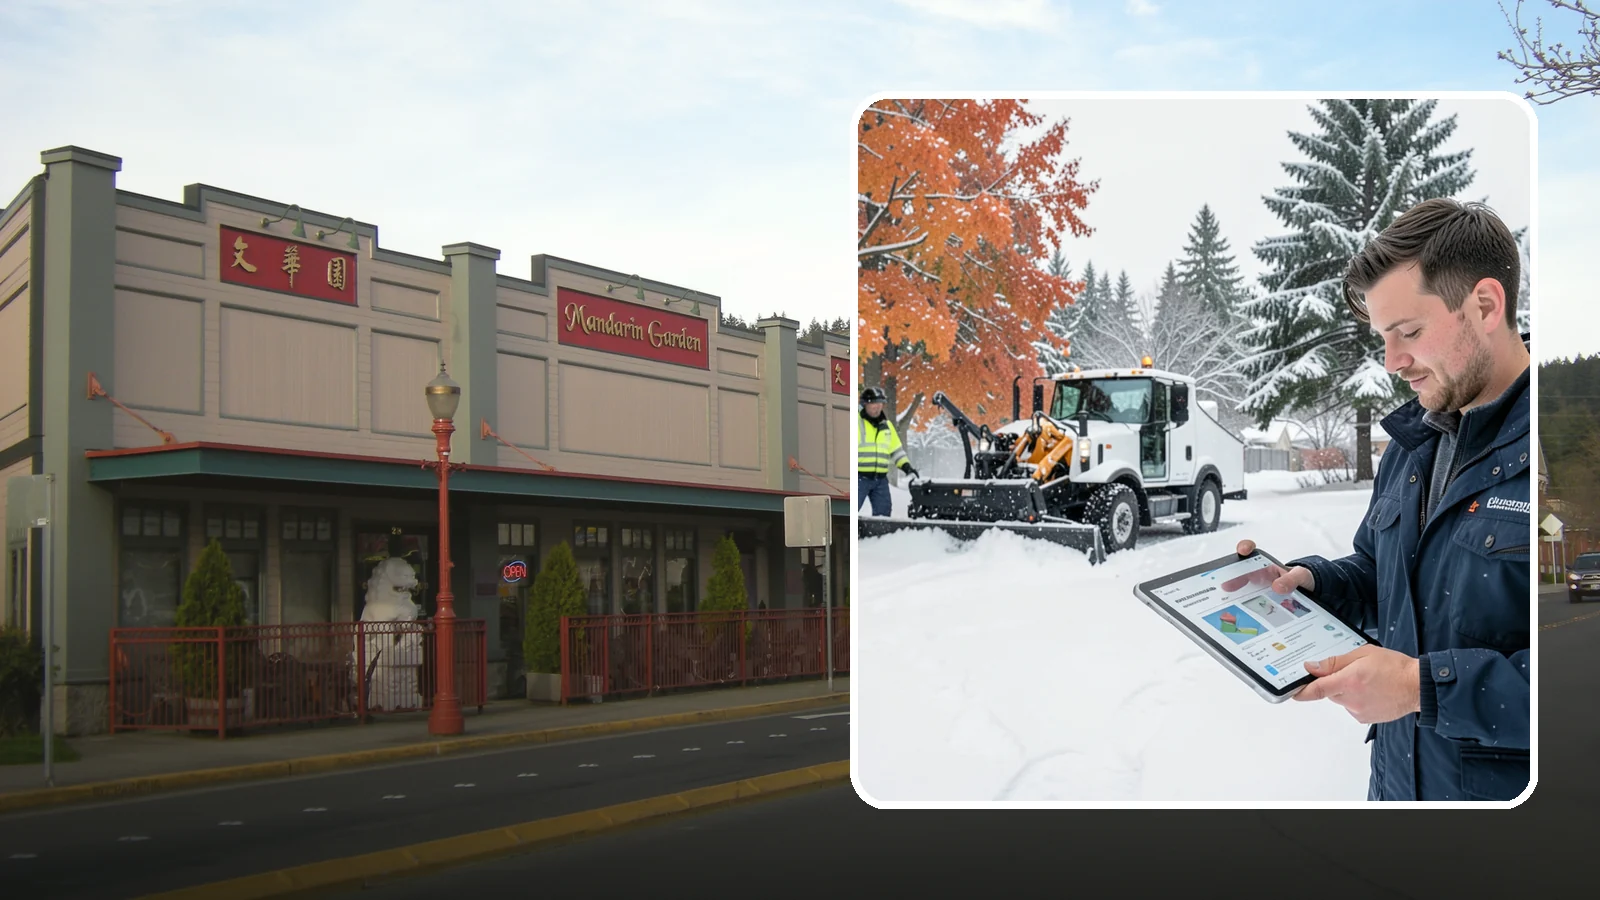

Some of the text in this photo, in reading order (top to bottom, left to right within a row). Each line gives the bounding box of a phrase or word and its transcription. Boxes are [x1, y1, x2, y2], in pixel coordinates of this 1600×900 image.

[230, 235, 346, 291] 文華園
[564, 302, 701, 352] Mandarin Garden
[503, 566, 527, 578] OPEN
